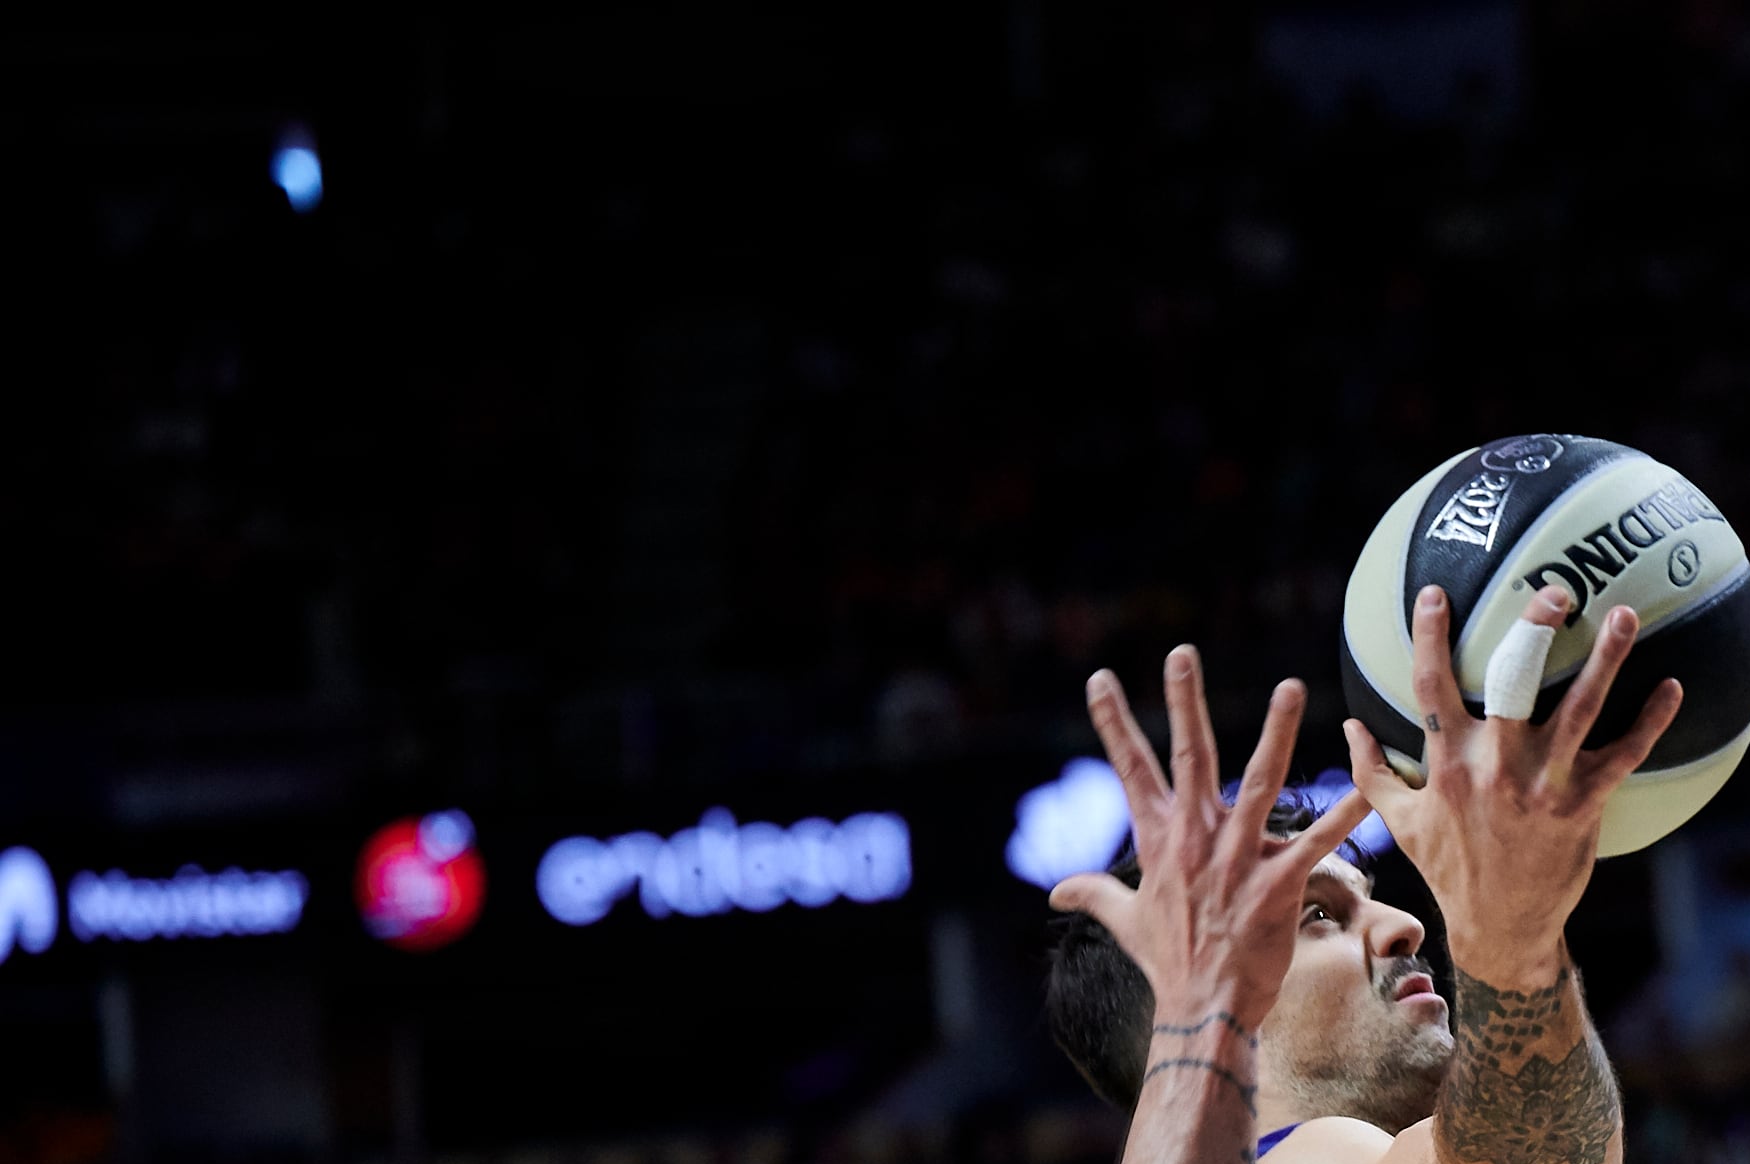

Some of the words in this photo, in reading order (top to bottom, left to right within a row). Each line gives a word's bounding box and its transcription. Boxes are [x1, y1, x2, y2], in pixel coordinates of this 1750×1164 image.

[1432, 472, 1509, 546] 2024
[1523, 479, 1726, 629] PALDING
[536, 807, 912, 927] endesa
